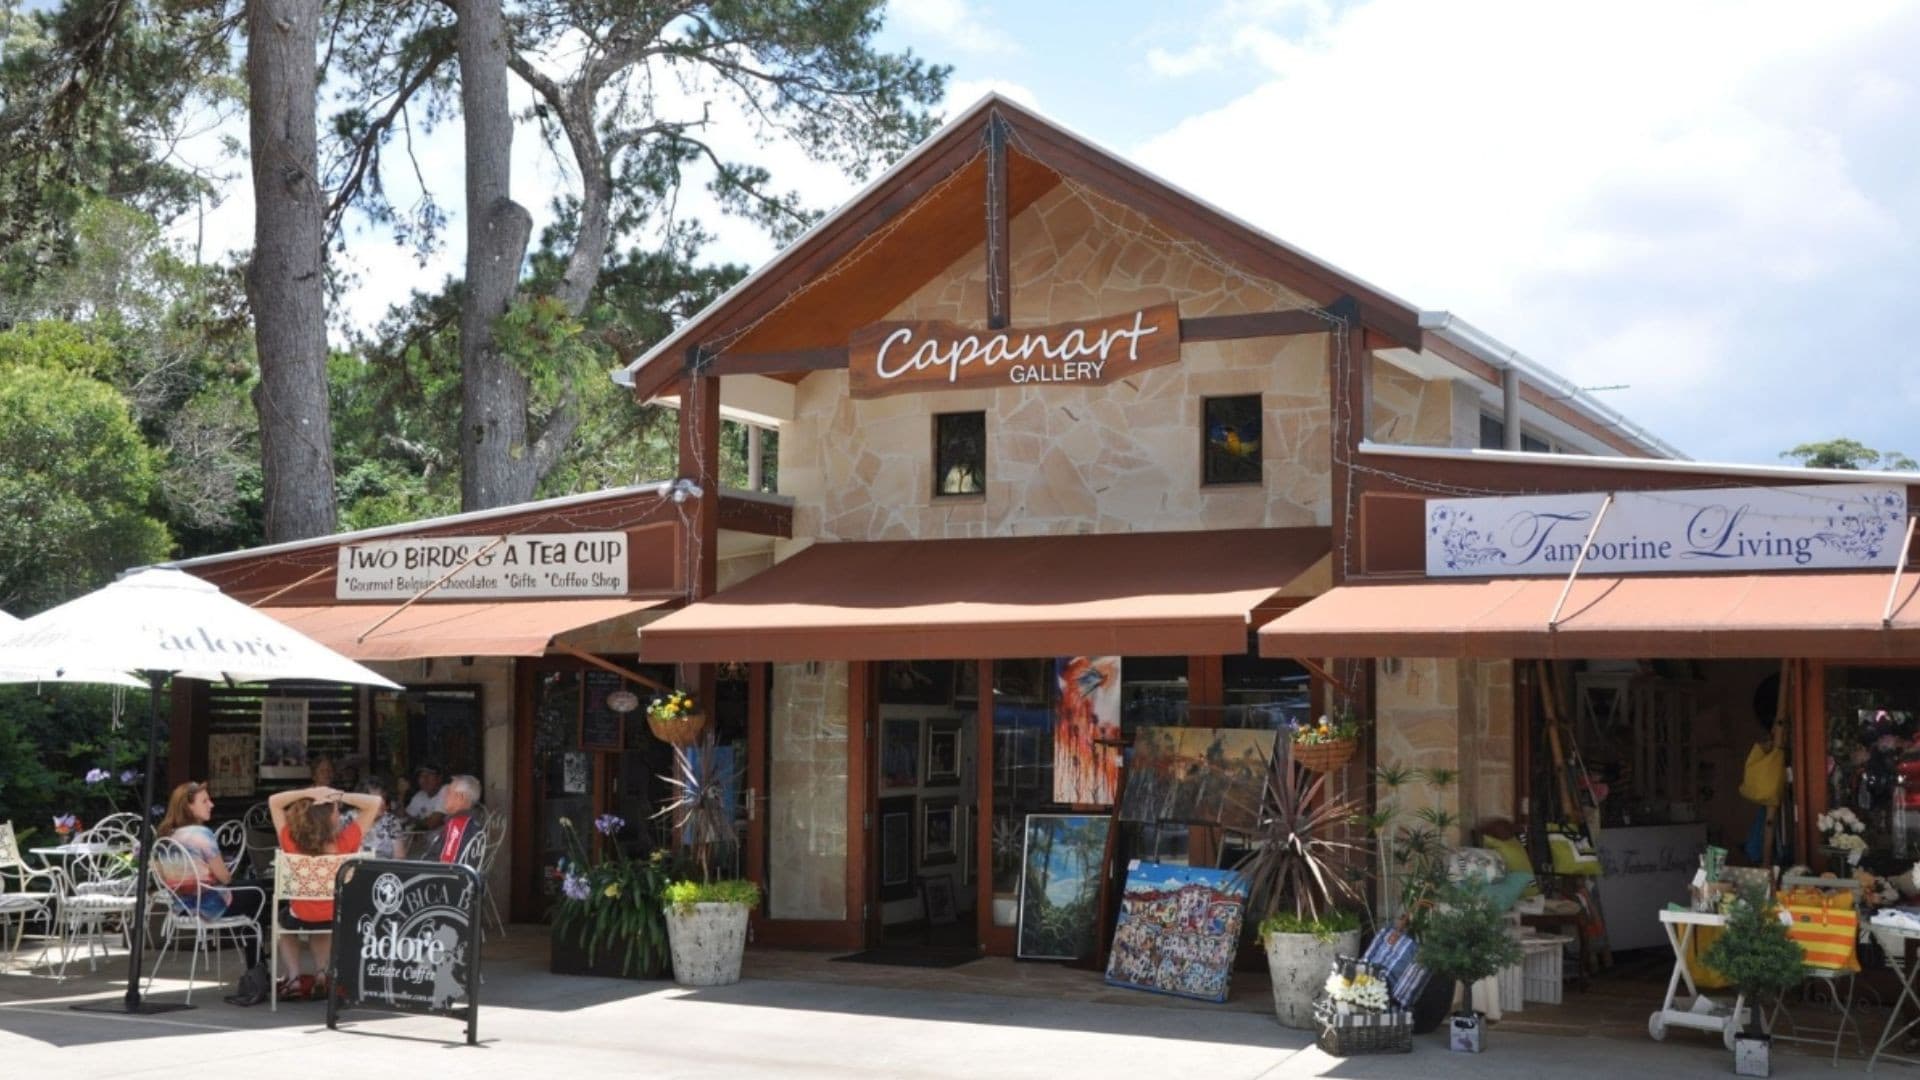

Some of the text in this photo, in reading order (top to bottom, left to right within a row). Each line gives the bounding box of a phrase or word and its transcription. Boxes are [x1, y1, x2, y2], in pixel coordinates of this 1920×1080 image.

[876, 311, 1158, 383] Capanart
[1010, 361, 1105, 383] GALLERY
[1500, 503, 1813, 565] Tamborine Living
[347, 546, 397, 569] TWO
[474, 548, 496, 567] &
[503, 544, 518, 566] A
[574, 540, 621, 564] CUP
[591, 572, 621, 590] Shop
